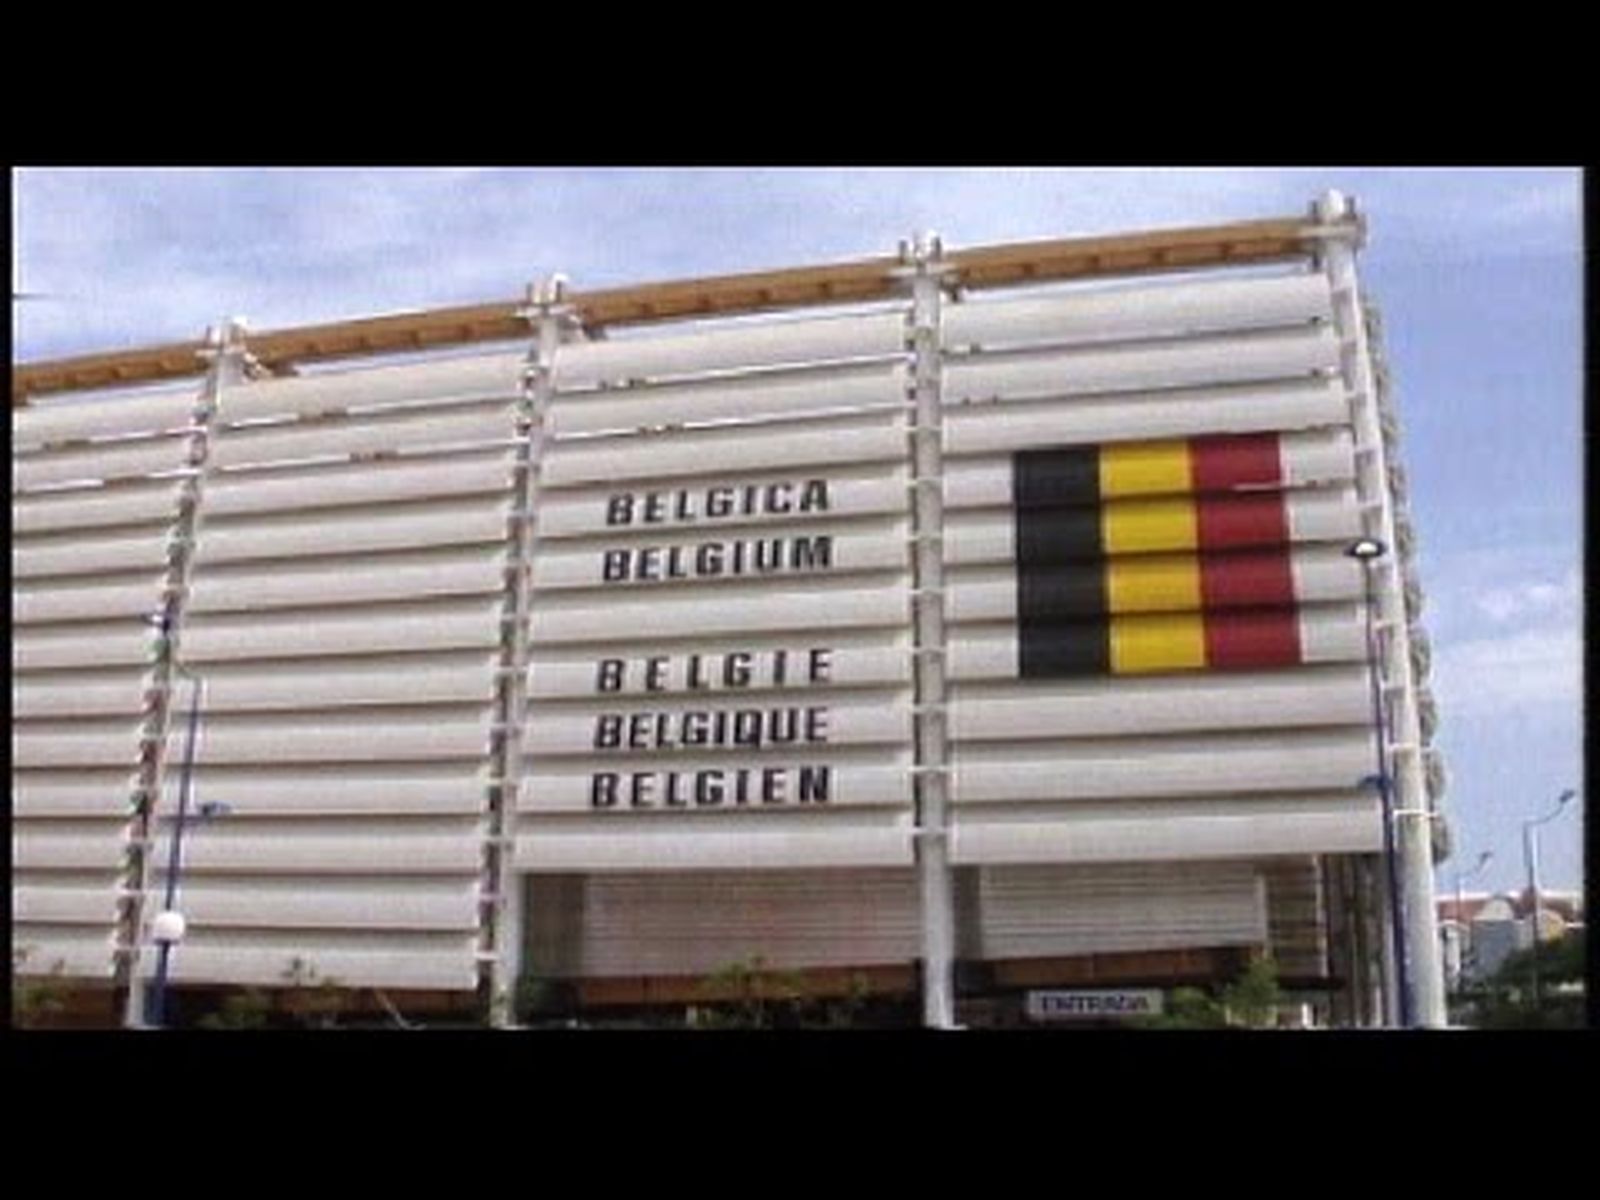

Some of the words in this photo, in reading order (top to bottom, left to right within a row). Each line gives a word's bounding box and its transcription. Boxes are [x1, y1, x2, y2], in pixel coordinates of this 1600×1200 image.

[606, 479, 829, 526] BELGICA
[603, 536, 833, 582] BELGIUM
[597, 648, 833, 693] BELGIE
[594, 706, 829, 750] BELGIQUE
[591, 765, 830, 807] BELGIEN
